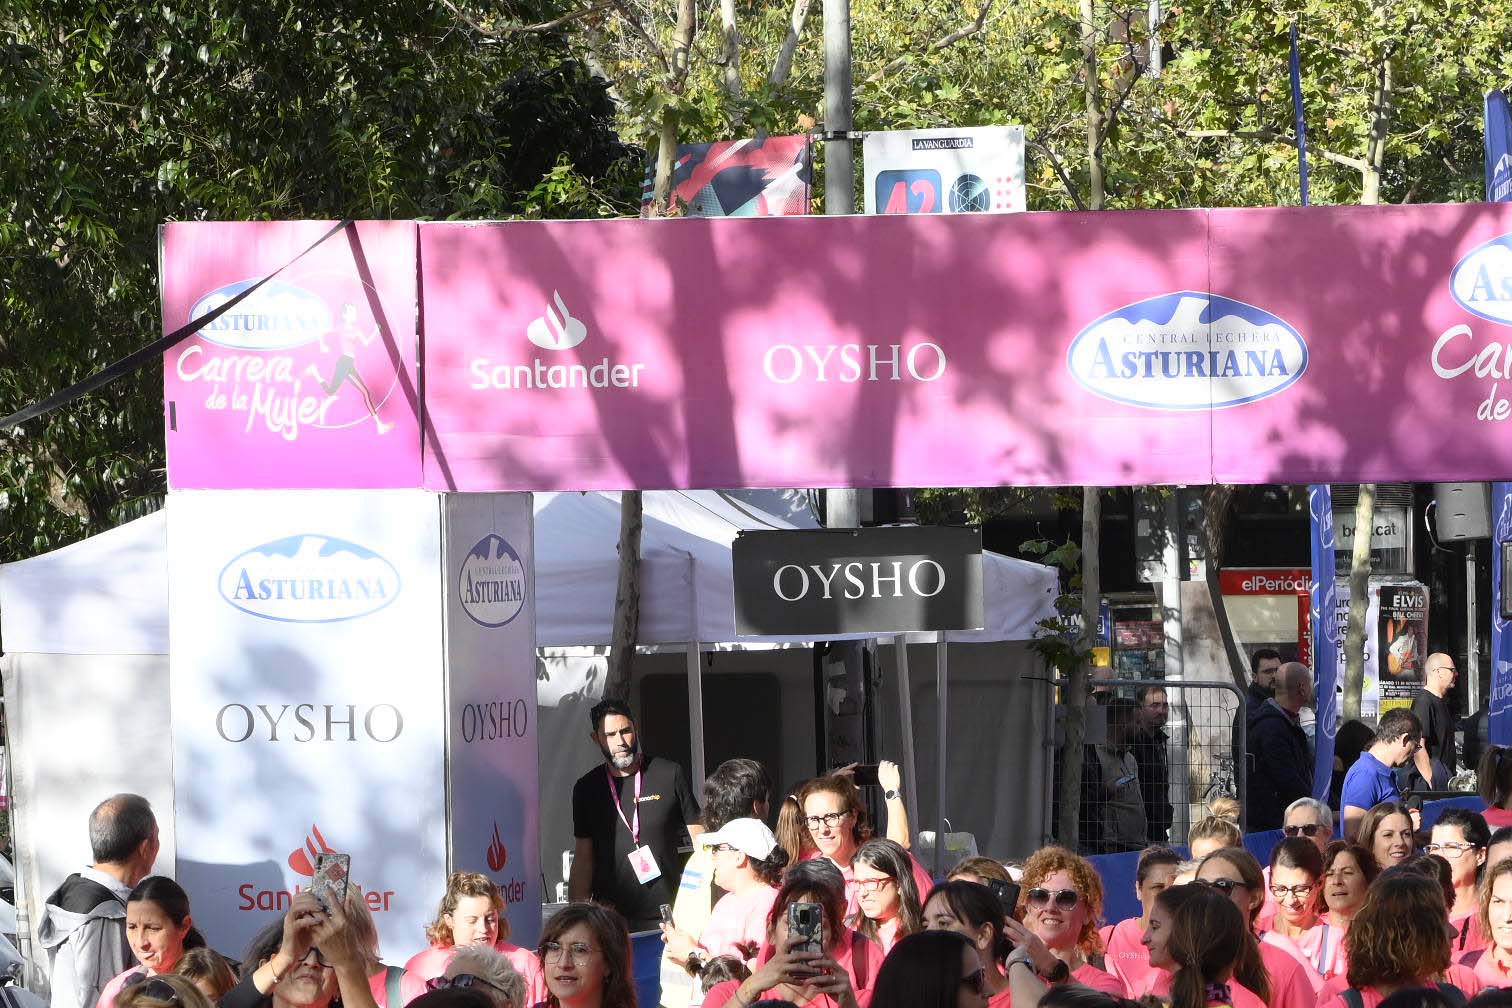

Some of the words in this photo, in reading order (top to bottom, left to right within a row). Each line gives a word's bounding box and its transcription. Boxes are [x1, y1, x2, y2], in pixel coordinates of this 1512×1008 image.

[177, 345, 294, 382] Carrera
[471, 358, 644, 389] Santander
[763, 343, 946, 383] OYSHO
[1087, 337, 1289, 380] ASTURIANA
[206, 383, 226, 410] de
[232, 384, 248, 410] la
[245, 380, 339, 441] Mujer
[1477, 381, 1511, 421] de
[233, 567, 387, 600] ASTURIANA
[464, 563, 522, 605] ASTURIANA
[773, 560, 946, 601] OYSHO
[1393, 595, 1424, 607] ELVIS
[216, 703, 403, 743] OYSHO
[462, 699, 527, 743] OYSHO
